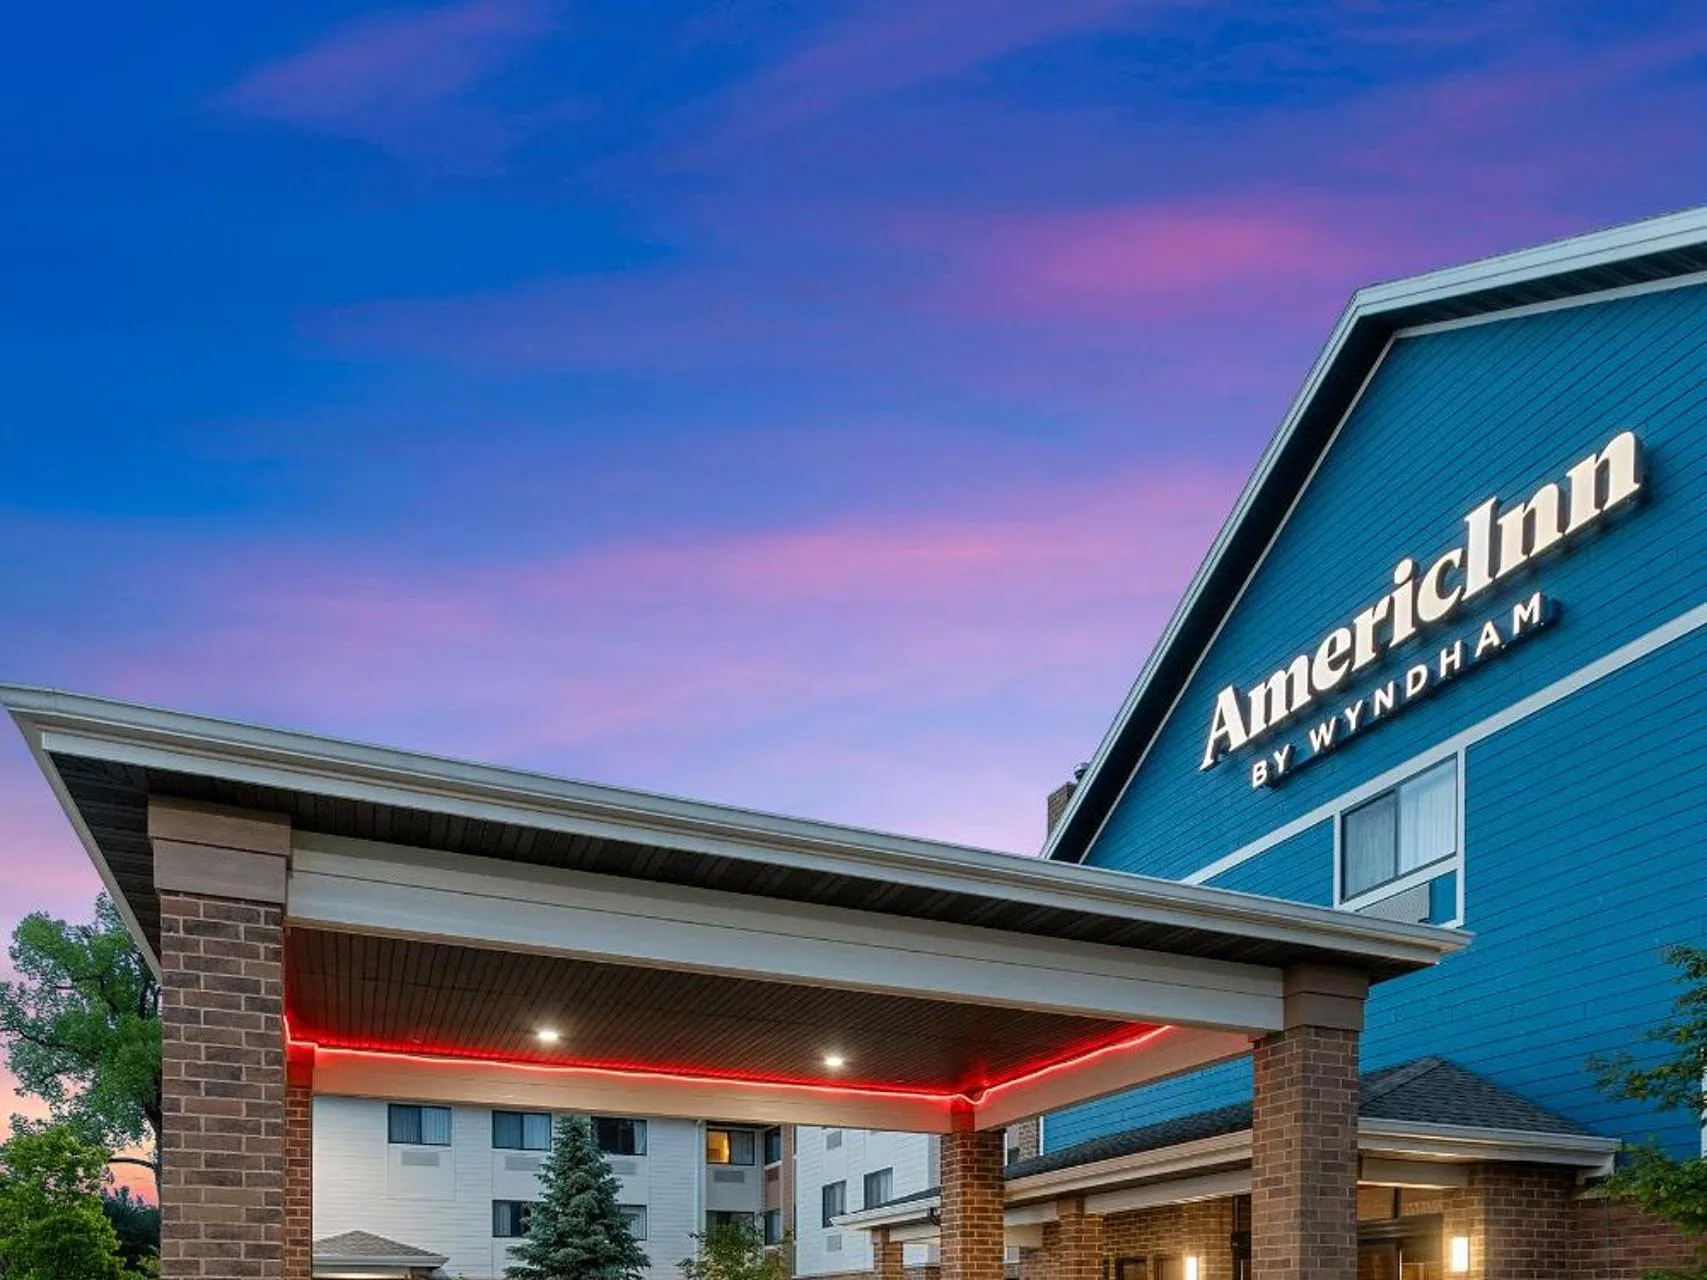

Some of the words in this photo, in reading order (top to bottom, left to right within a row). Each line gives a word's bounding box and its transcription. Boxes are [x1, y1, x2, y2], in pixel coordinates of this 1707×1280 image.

[1199, 430, 1642, 771] AmericInn
[1251, 745, 1291, 788] BY
[1309, 592, 1543, 755] WYNDHAM
